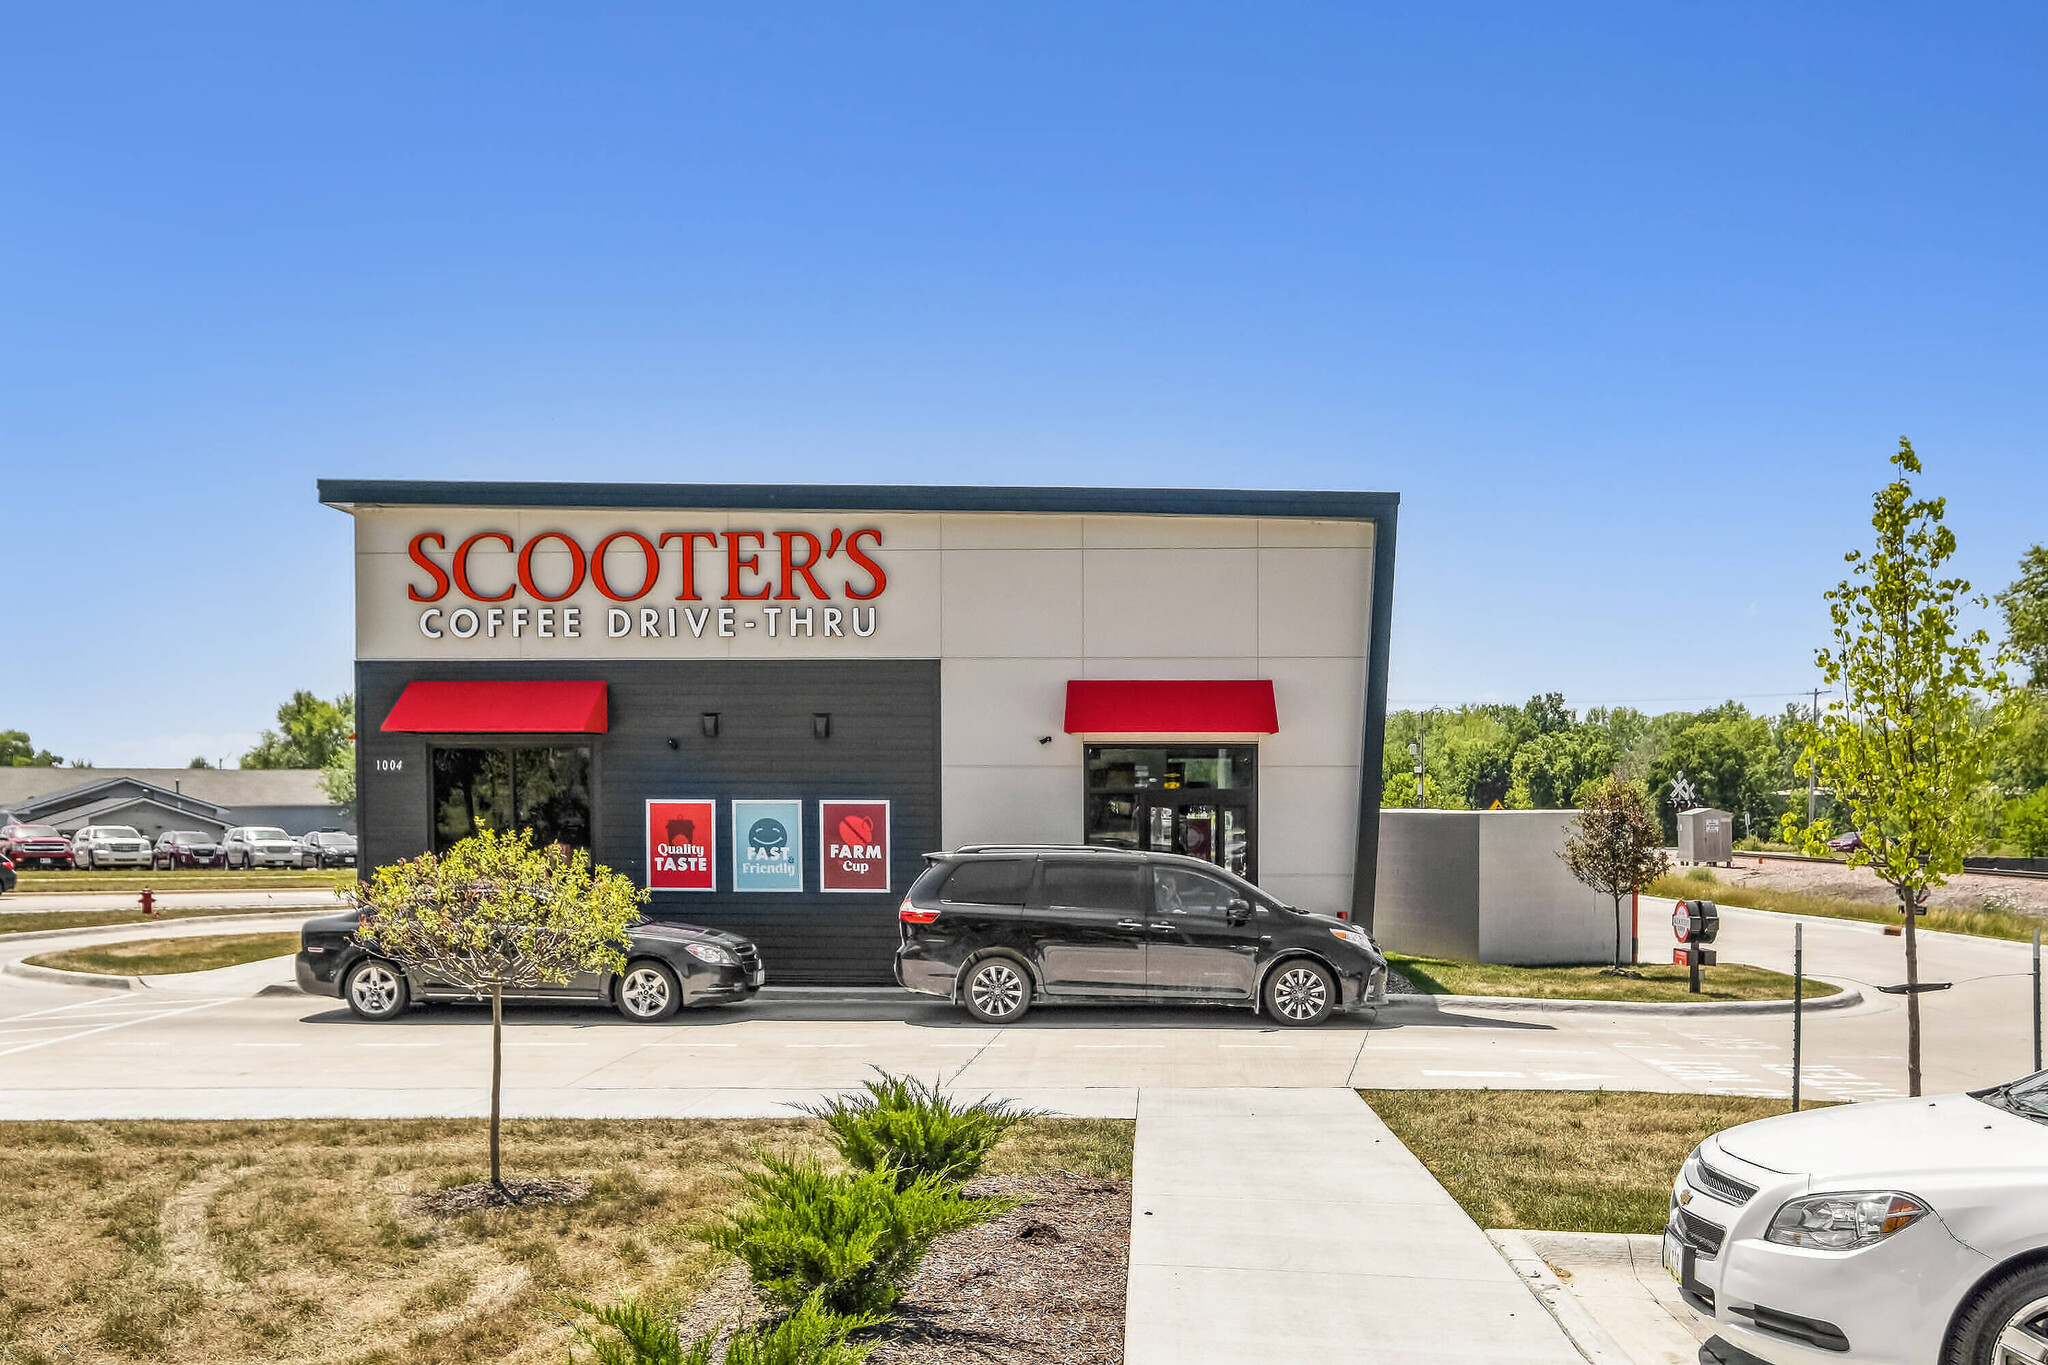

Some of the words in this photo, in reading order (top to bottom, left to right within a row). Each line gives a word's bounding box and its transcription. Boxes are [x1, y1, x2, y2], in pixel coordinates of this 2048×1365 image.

[407, 528, 887, 603] SCOOTER'S
[419, 607, 582, 639] COFFEE
[607, 606, 877, 638] DRIVE-THRU
[376, 759, 403, 771] 1004
[657, 843, 705, 858] Quality
[747, 846, 790, 861] FAST
[830, 844, 882, 859] FARM
[654, 857, 707, 872] TASTE
[742, 862, 795, 877] Friendly
[842, 860, 869, 874] Cup
